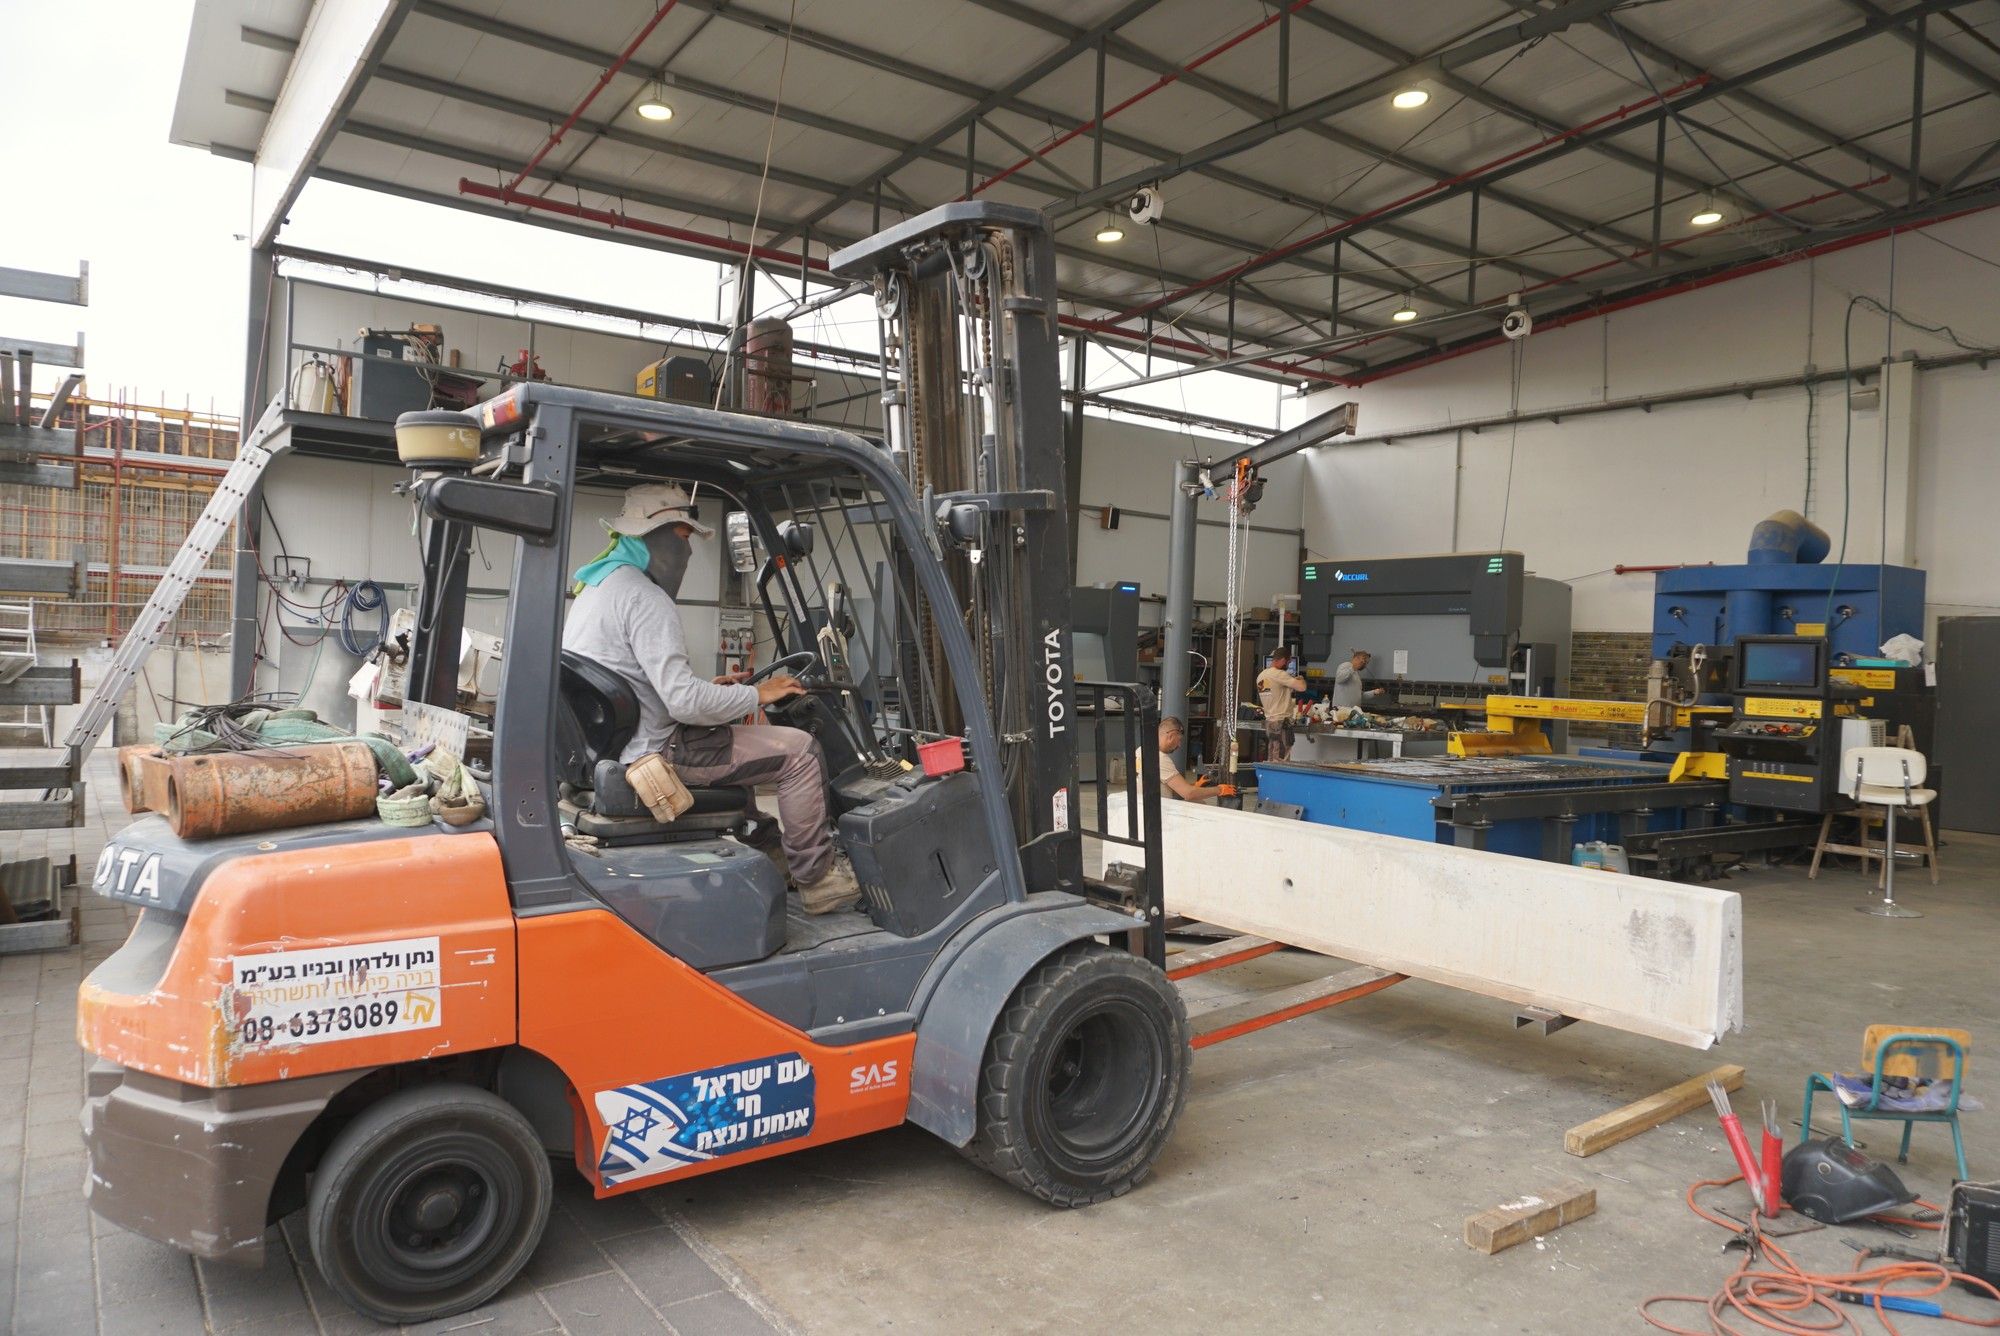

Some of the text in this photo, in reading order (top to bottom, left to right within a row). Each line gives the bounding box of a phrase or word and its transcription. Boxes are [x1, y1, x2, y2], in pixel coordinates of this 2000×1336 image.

[1342, 573, 1369, 581] ACCURL
[1044, 628, 1066, 739] TOYOTA
[302, 959, 343, 977] ובניו
[349, 951, 400, 977] ולדמן
[406, 950, 434, 970] נתן
[396, 969, 436, 989] בניה
[243, 1000, 399, 1044] 08-6378089
[693, 1058, 810, 1102] עם ישראל
[850, 1060, 897, 1088] SAS
[737, 1094, 762, 1117] חי
[697, 1107, 810, 1151] אנחנו ננצח
